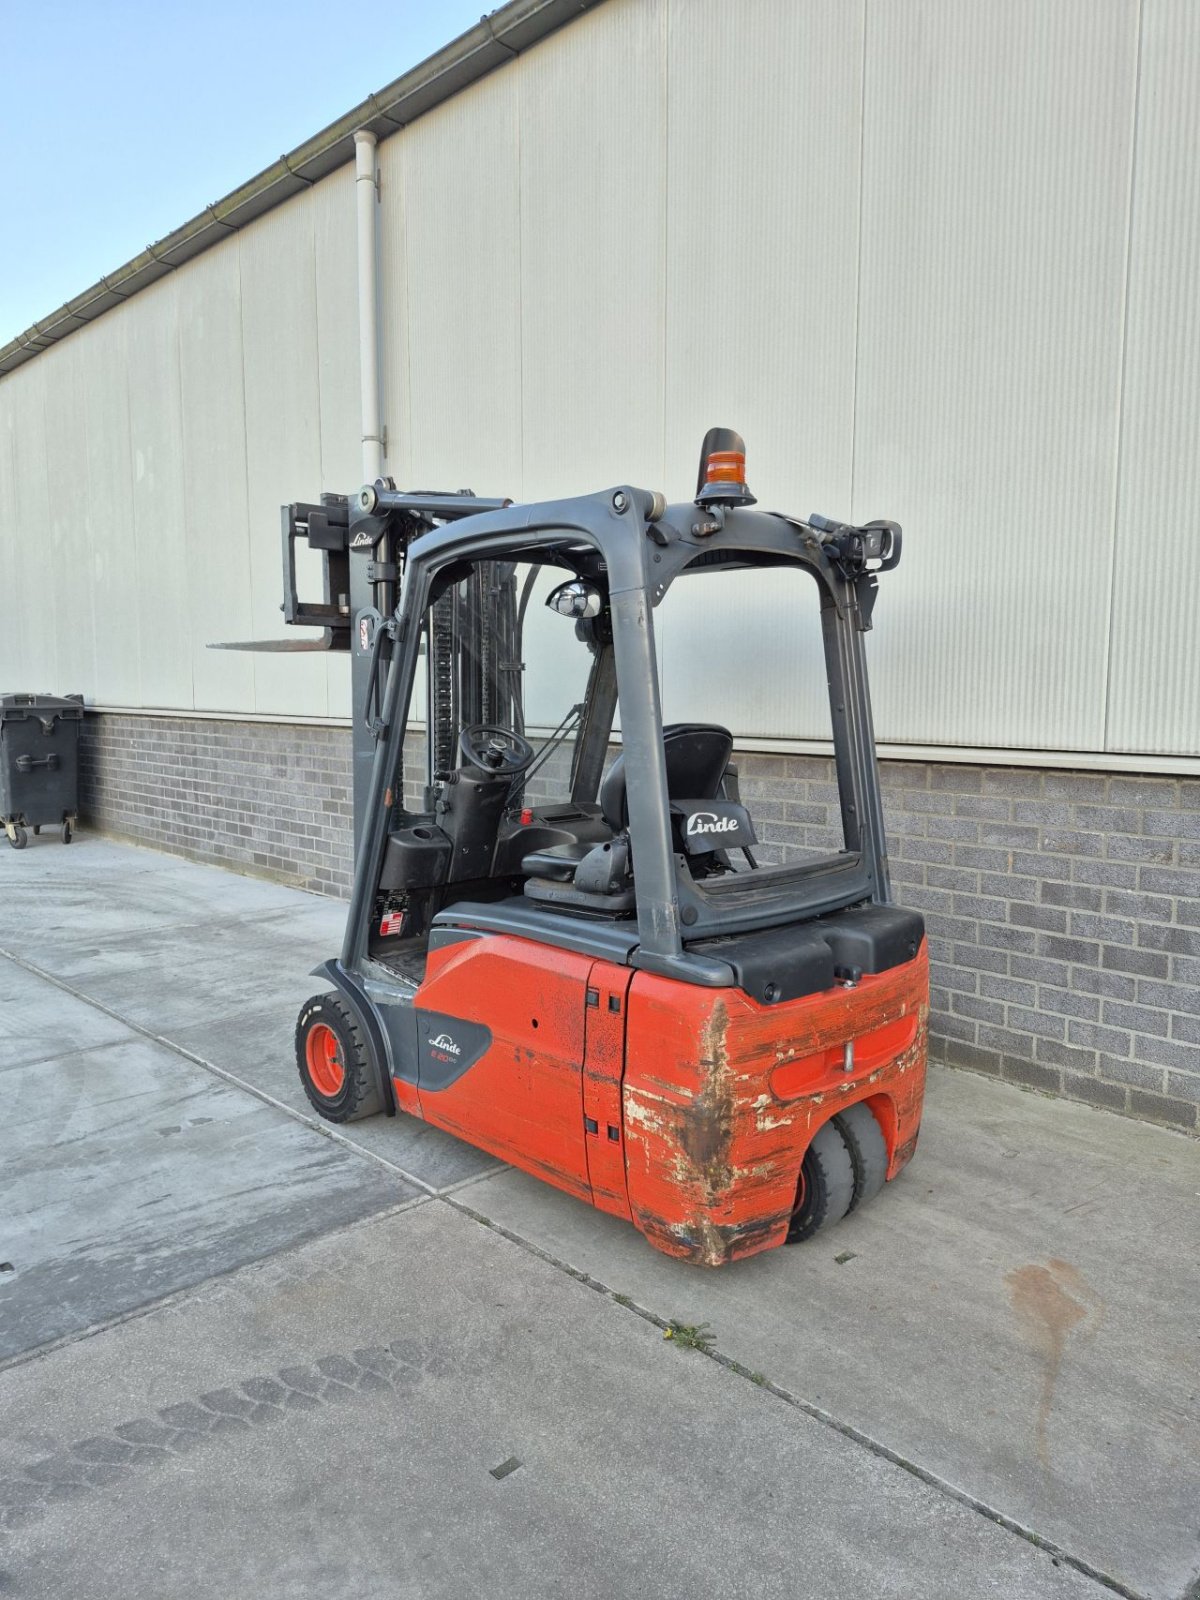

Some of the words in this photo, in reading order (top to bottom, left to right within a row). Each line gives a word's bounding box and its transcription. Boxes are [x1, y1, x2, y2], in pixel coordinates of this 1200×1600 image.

[350, 532, 373, 547] Linde
[687, 812, 739, 835] Linde
[428, 1034, 461, 1055] Linde
